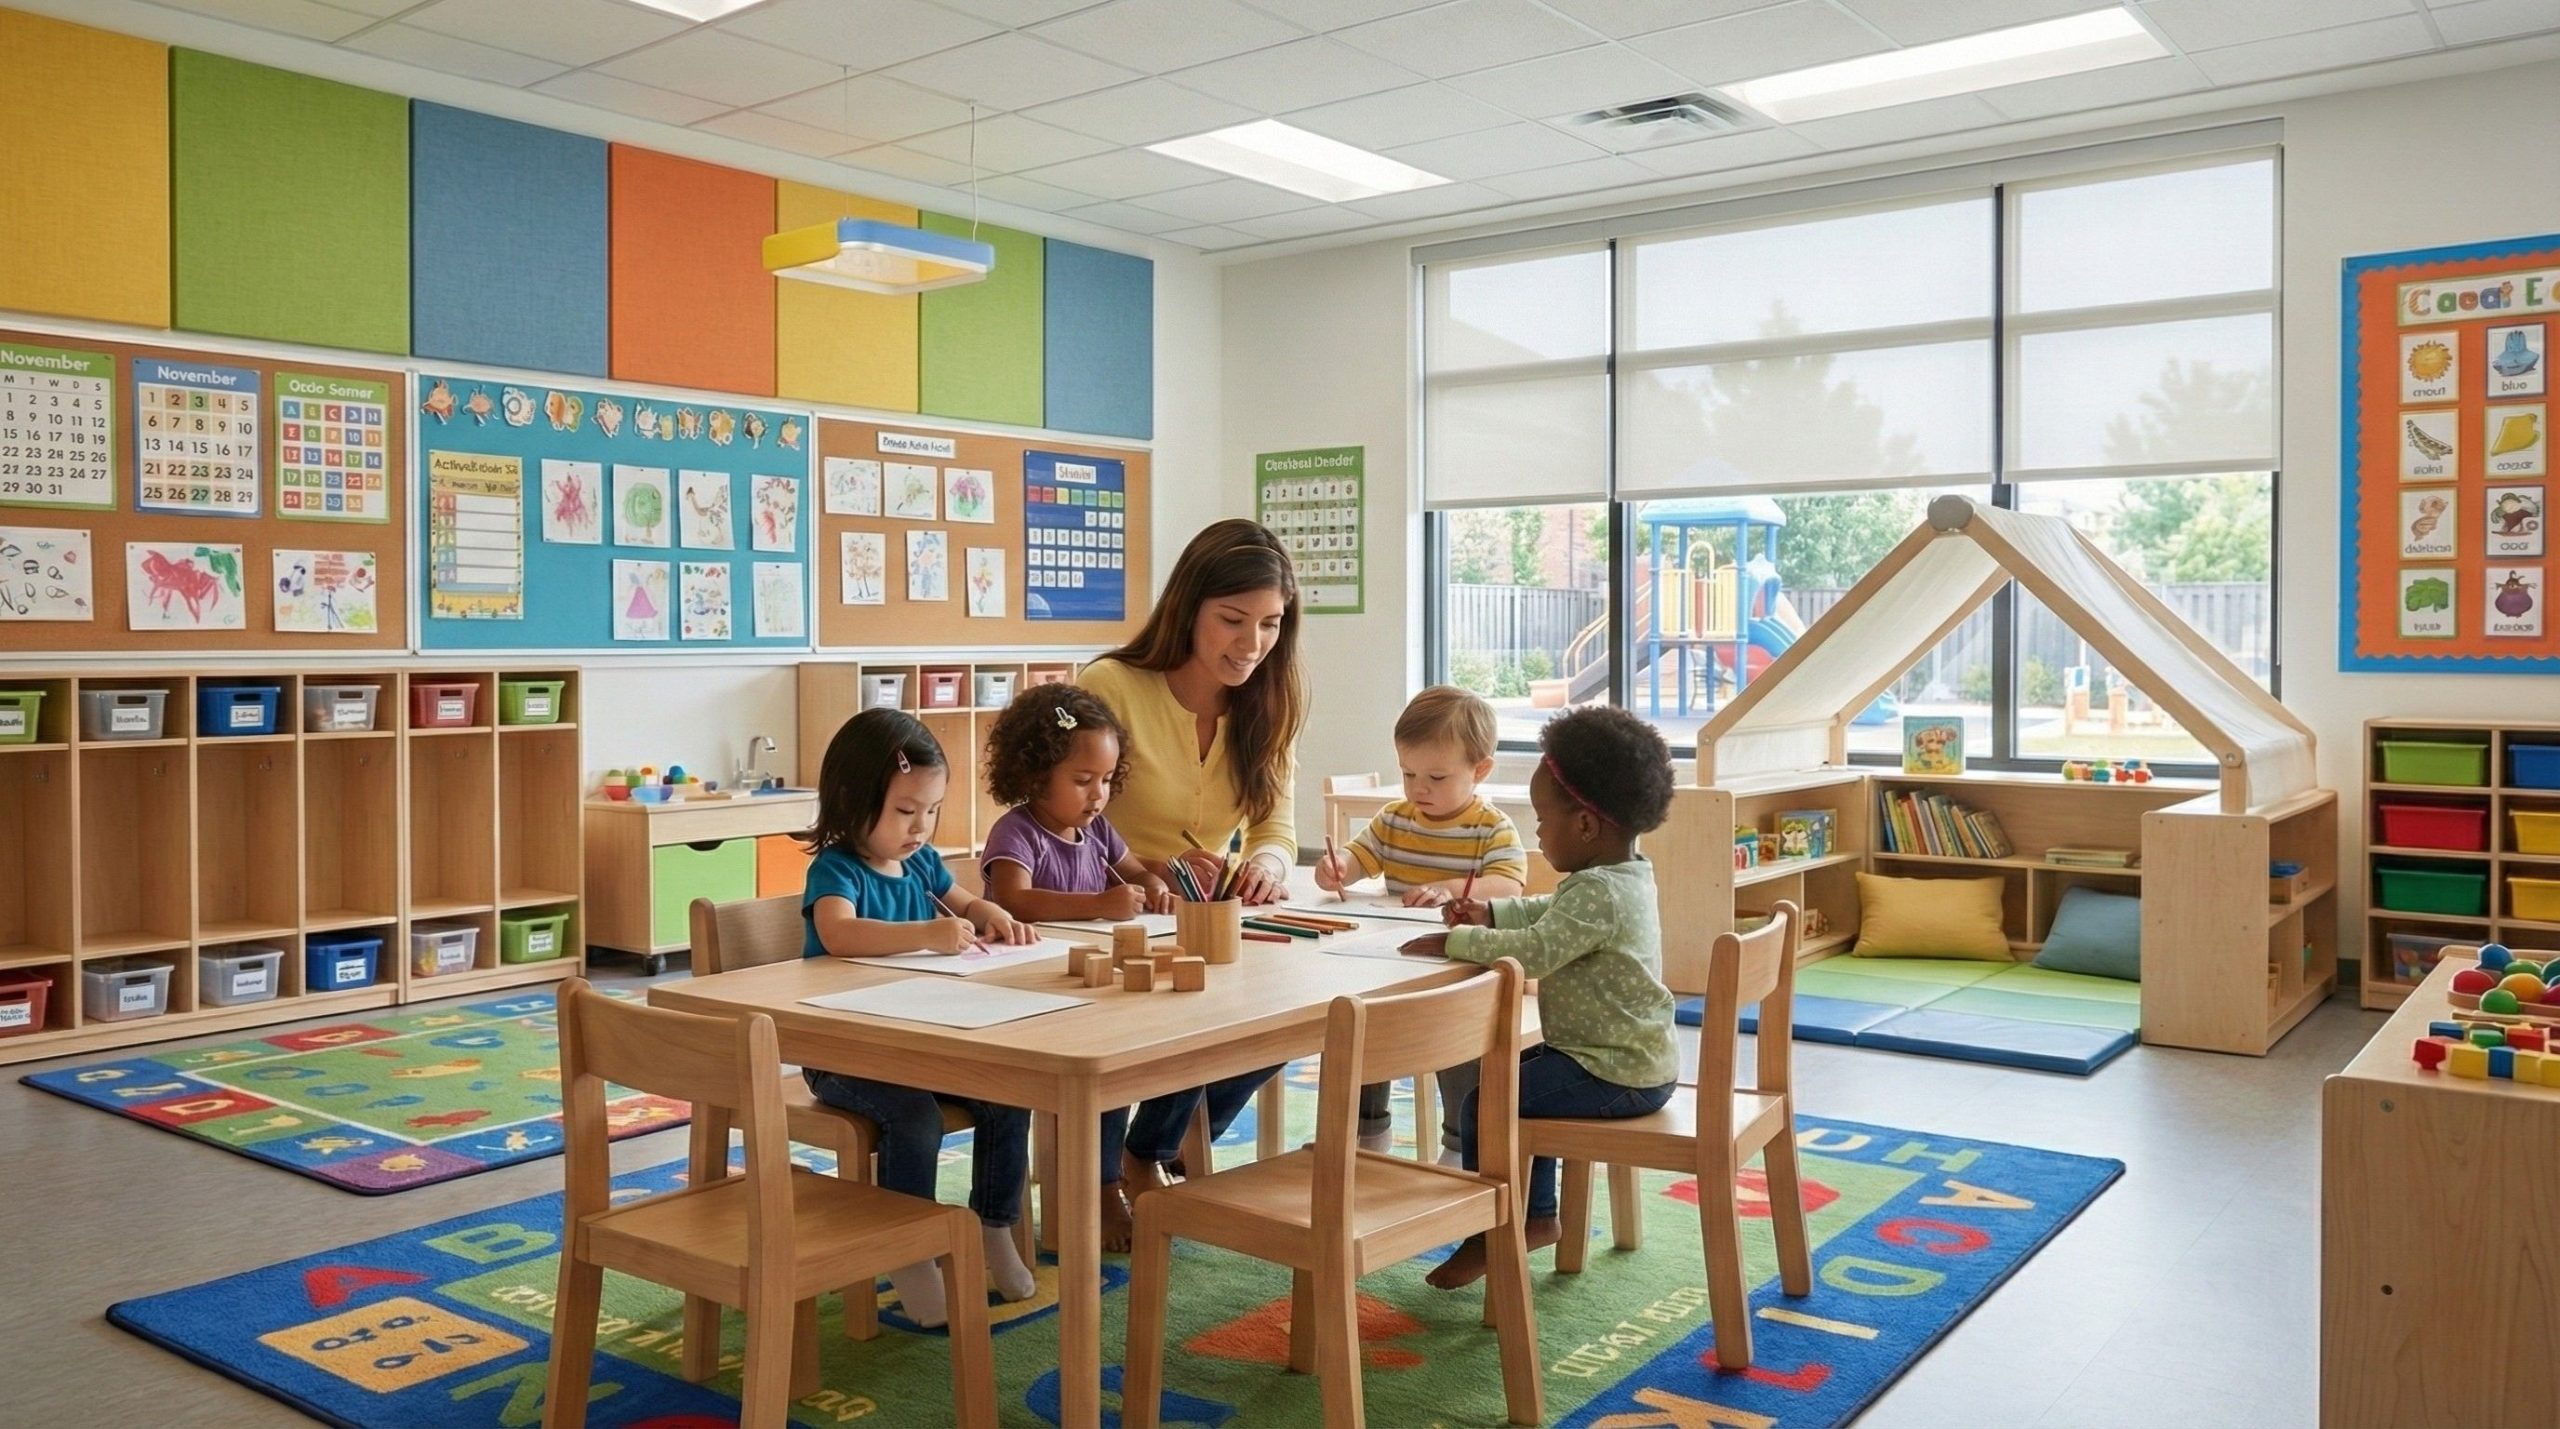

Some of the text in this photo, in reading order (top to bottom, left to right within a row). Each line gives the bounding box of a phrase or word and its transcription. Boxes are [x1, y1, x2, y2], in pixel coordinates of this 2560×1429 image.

[1, 350, 90, 371] November
[4, 375, 14, 383] M
[29, 377, 35, 385] T
[49, 379, 59, 387] W
[95, 383, 101, 391] S
[158, 366, 237, 385] November
[8, 392, 12, 403] 1
[29, 395, 36, 405] 2
[51, 396, 58, 407] 3
[72, 398, 80, 408] 4
[150, 392, 249, 411] 1 2 3 4 5
[7, 411, 105, 427] 8 9 10 11 12
[148, 416, 252, 434] 6 7 8 9 10
[4, 429, 105, 445] 15 16 17 18 19
[3, 447, 19, 457] 22
[25, 448, 41, 458] 23
[70, 451, 85, 461] 25
[91, 452, 106, 462] 26
[145, 438, 252, 457] 13 14 15 16 17
[25, 466, 41, 475] 23
[48, 467, 64, 477] 23
[91, 470, 107, 479] 27
[145, 463, 253, 479] 21 22 23 23 24
[3, 482, 62, 495] 29 30 31
[144, 487, 162, 498] 25
[168, 488, 186, 500] 26
[215, 491, 231, 502] 28
[238, 492, 253, 502] 29
[1917, 1179, 2037, 1210] A
[421, 1222, 557, 1265] B
[302, 1265, 430, 1310] A
